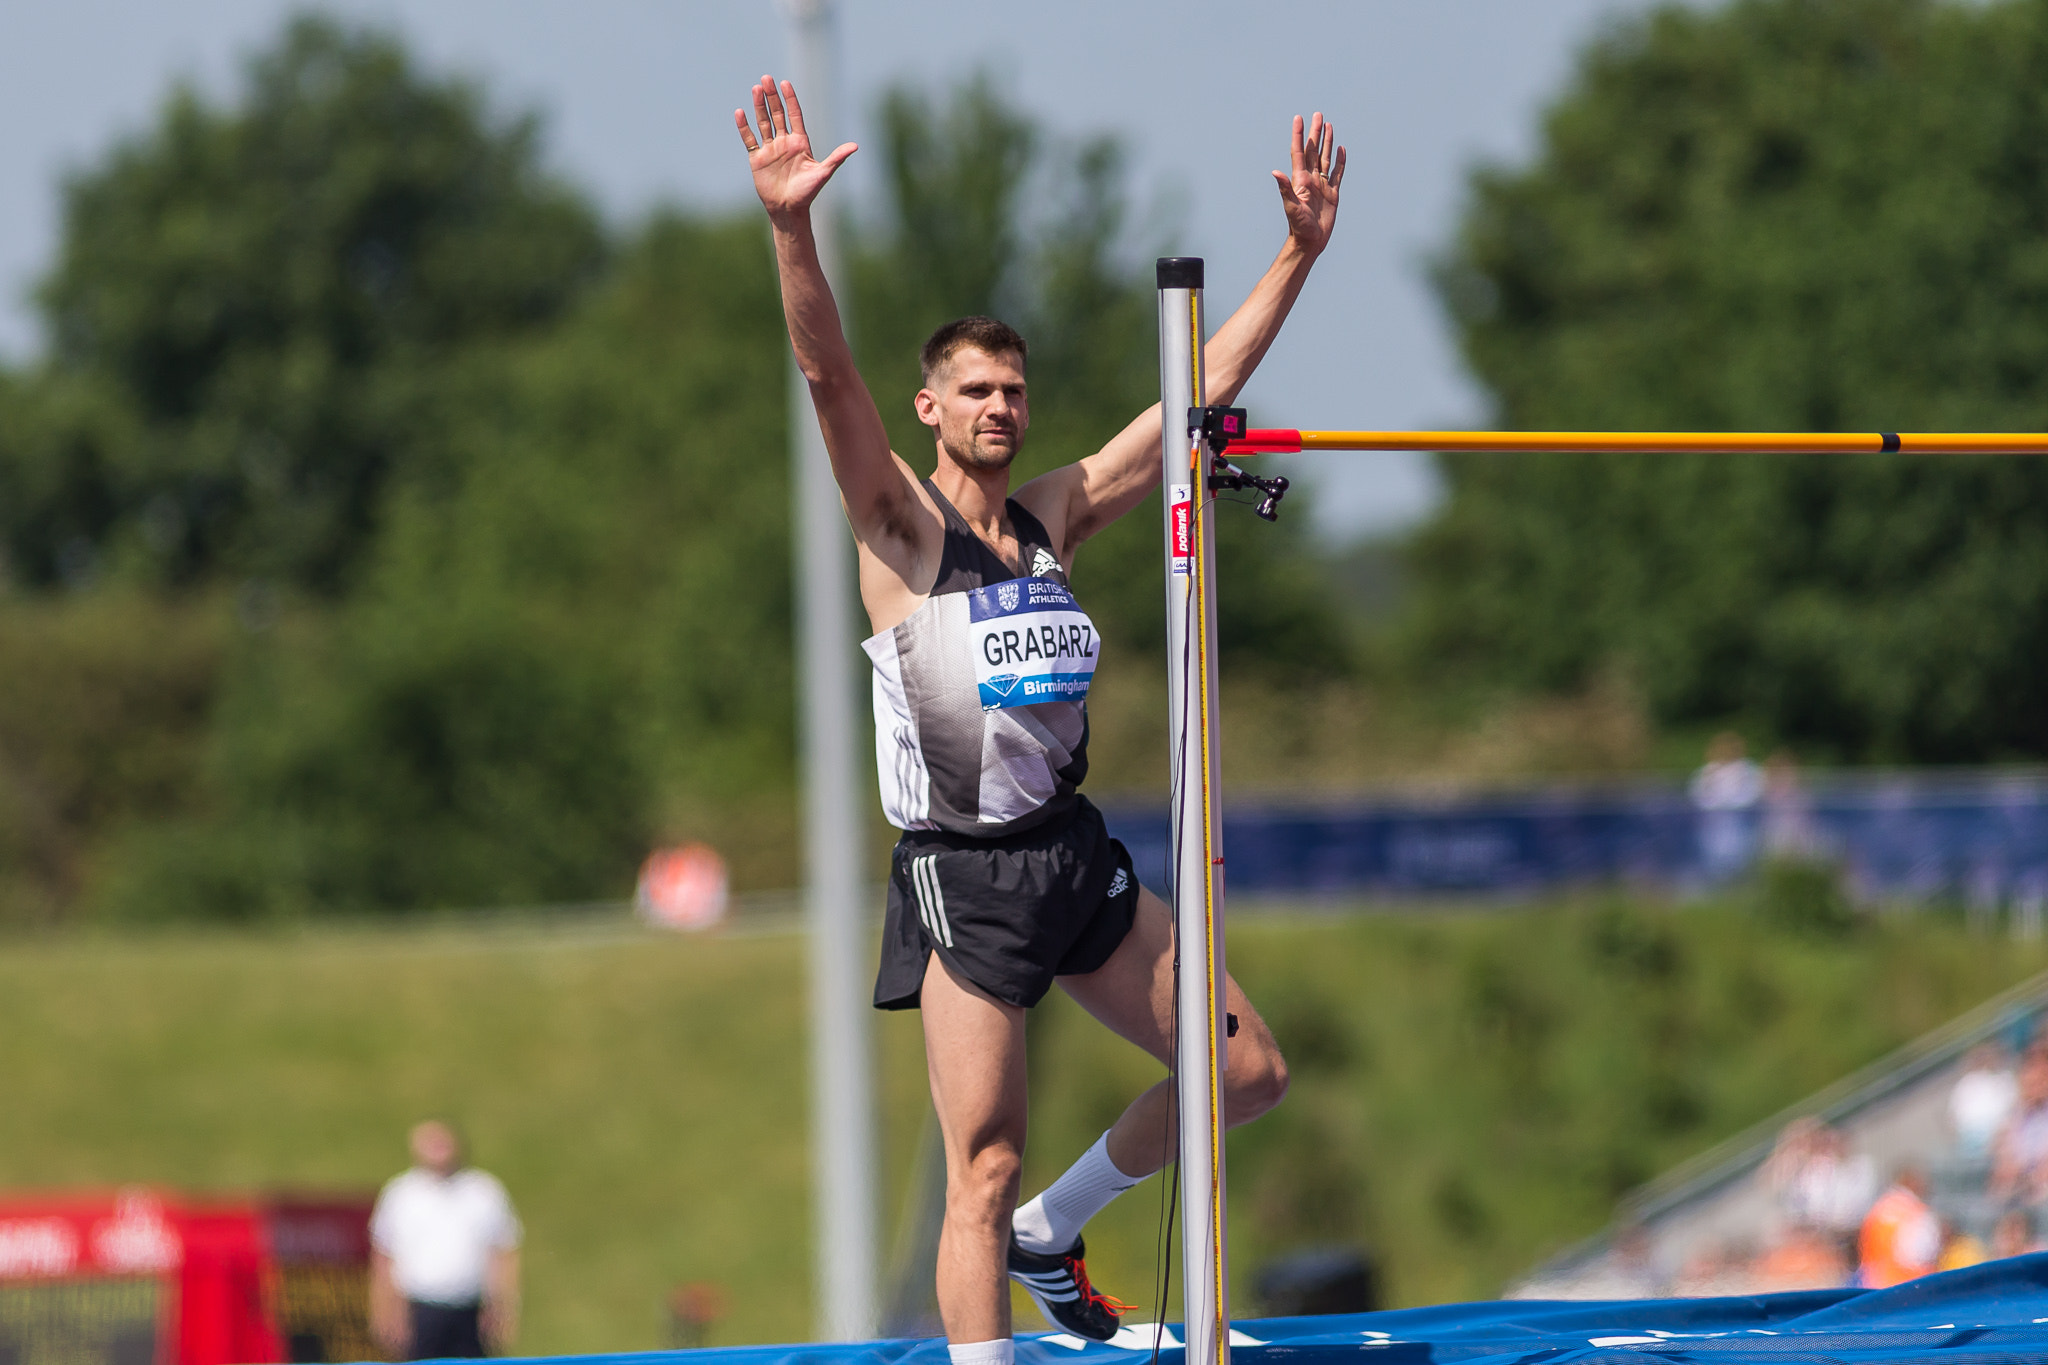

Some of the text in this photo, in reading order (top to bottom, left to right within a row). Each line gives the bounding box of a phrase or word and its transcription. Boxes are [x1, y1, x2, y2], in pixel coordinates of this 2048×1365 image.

[1176, 507, 1188, 552] polanik
[1028, 595, 1069, 605] ATHLETICS
[984, 625, 1093, 666] GRABARZ
[1023, 679, 1090, 696] Birmingham
